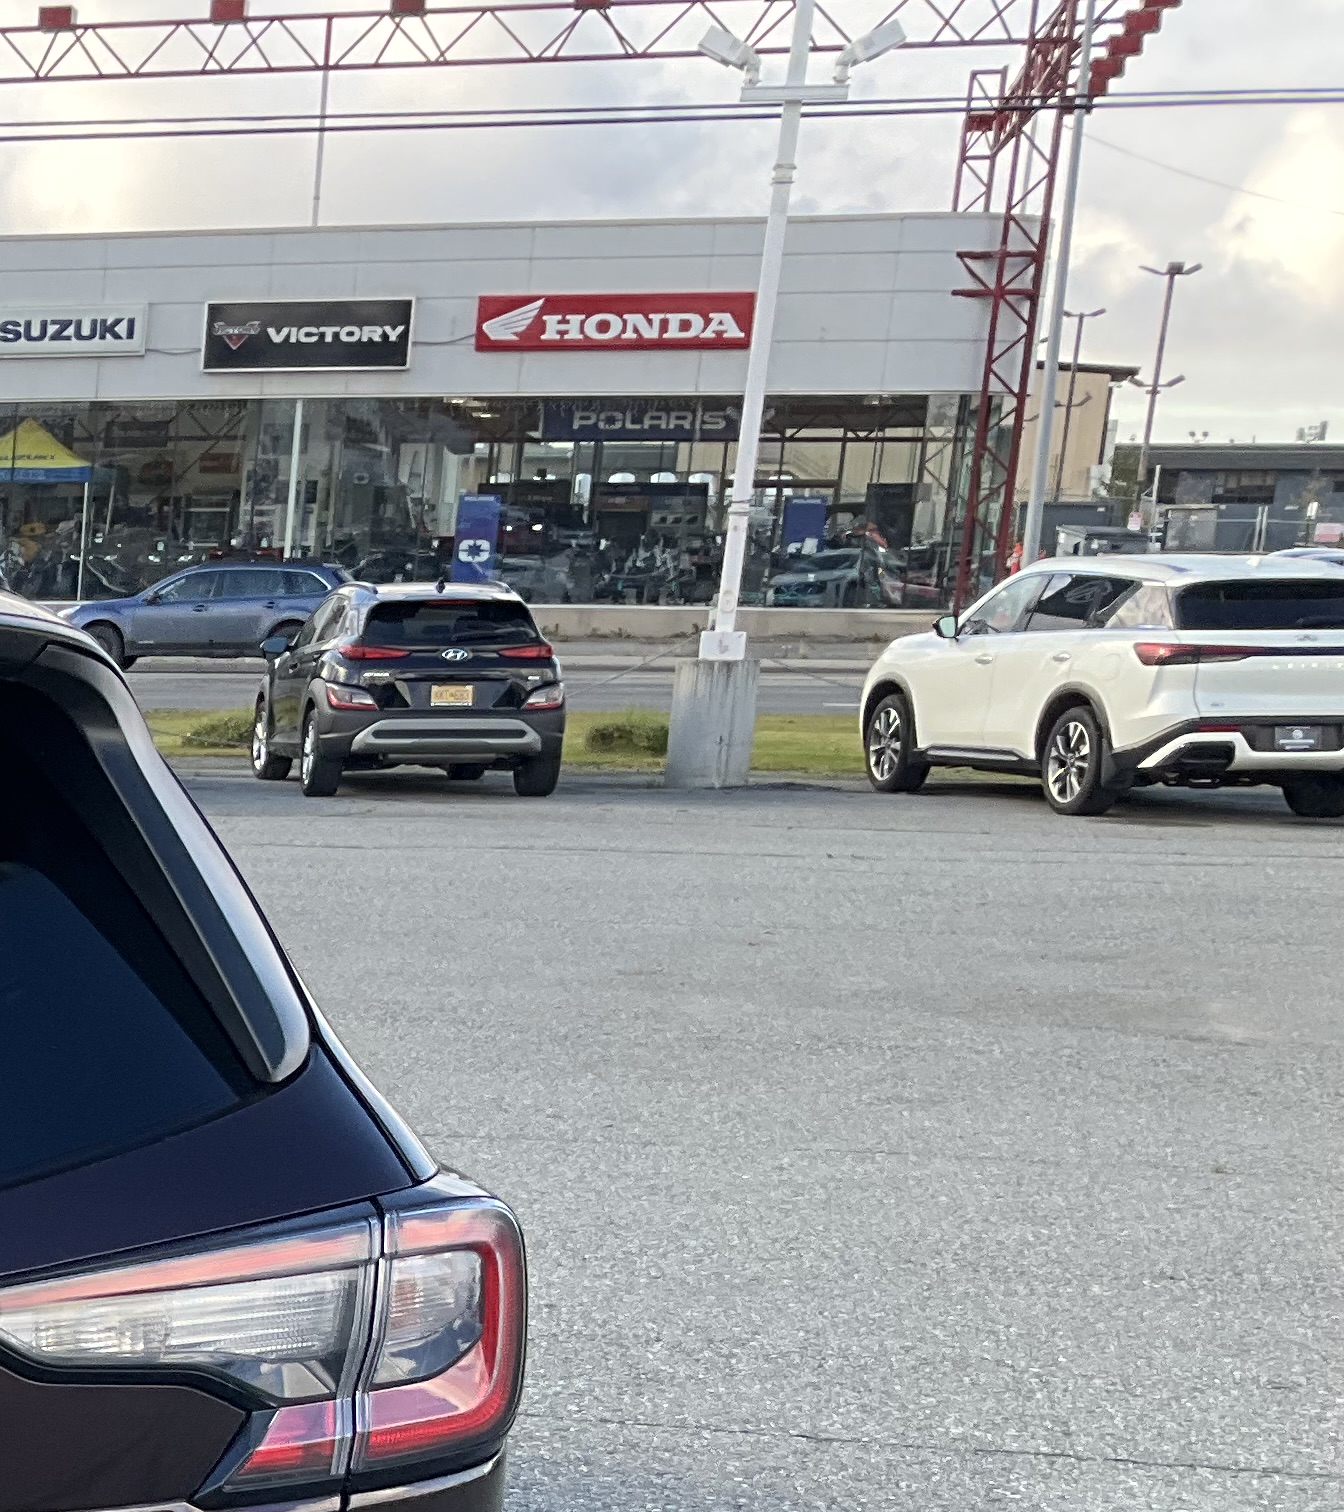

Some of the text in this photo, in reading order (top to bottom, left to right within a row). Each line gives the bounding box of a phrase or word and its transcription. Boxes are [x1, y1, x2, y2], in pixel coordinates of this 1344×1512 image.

[267, 325, 406, 344] VICTORY
[540, 312, 746, 341] HONDA
[572, 410, 727, 431] POLARIS
